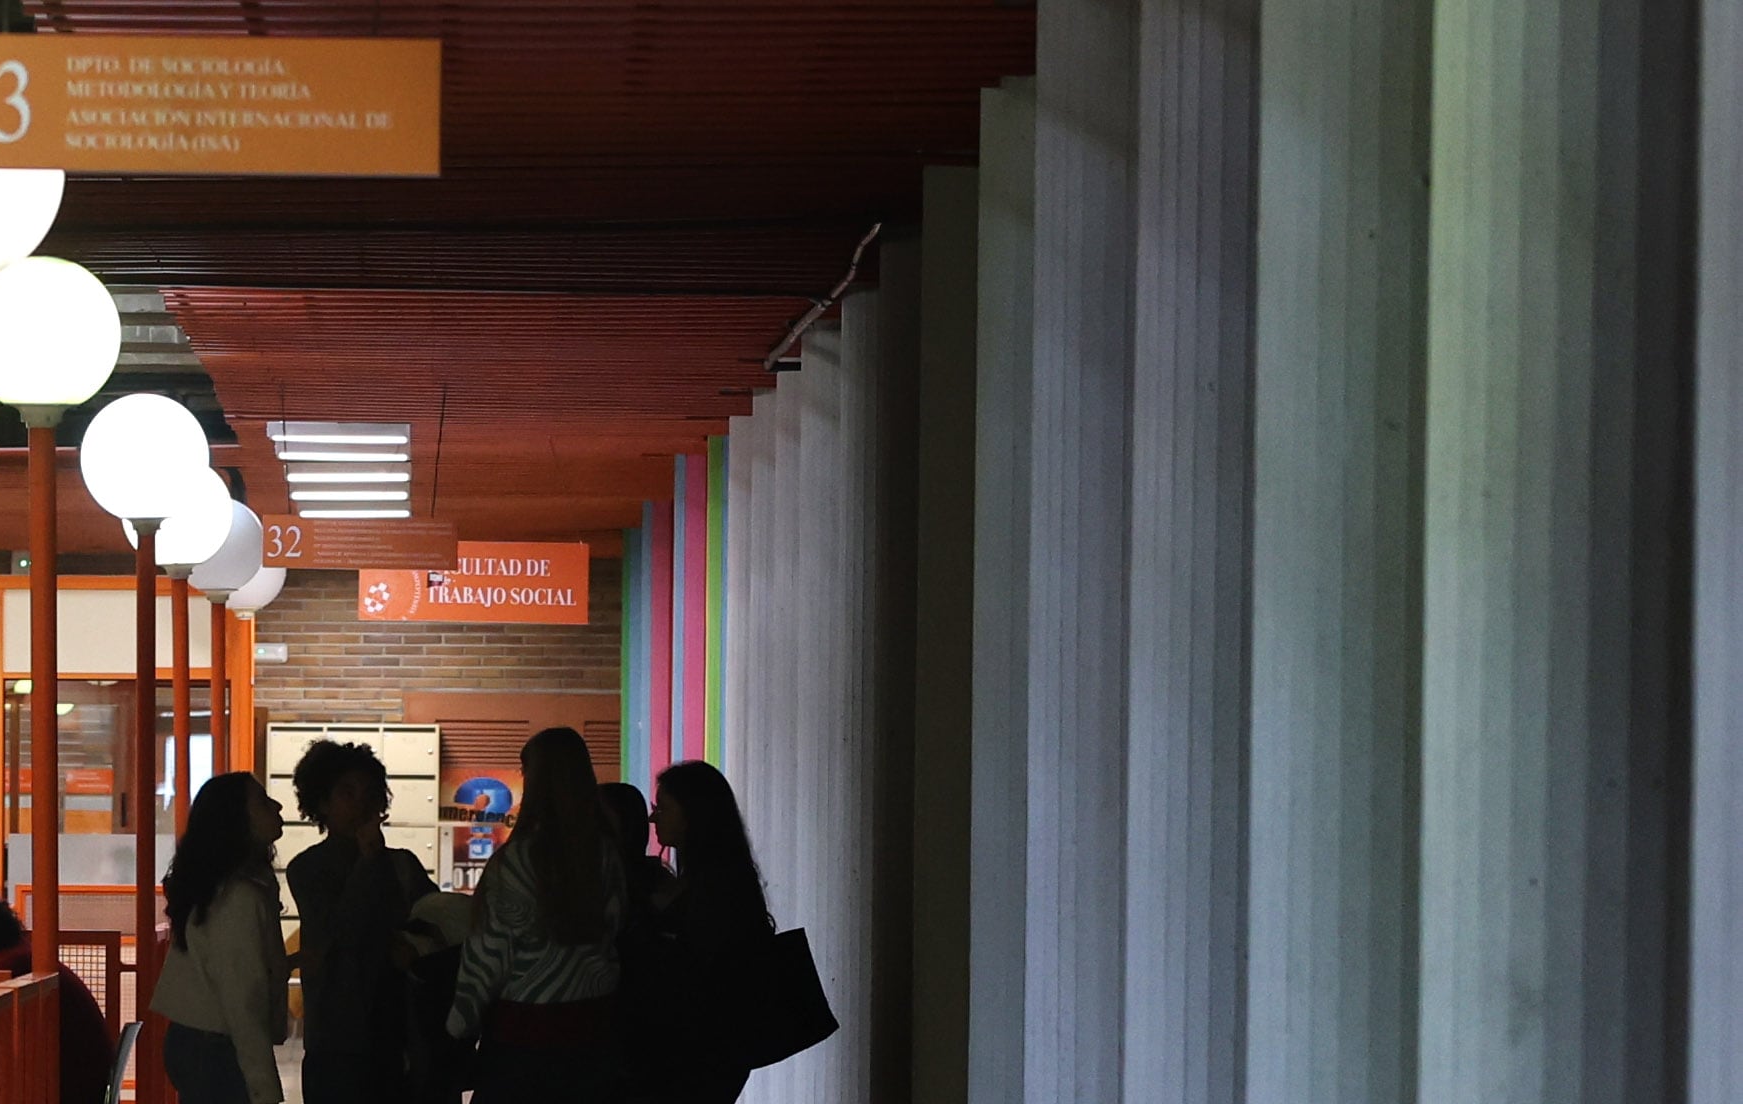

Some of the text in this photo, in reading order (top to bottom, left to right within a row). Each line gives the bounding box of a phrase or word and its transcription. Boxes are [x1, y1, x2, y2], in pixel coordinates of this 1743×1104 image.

[129, 58, 154, 74] DE
[218, 82, 232, 99] Y
[196, 110, 357, 128] INTERNACIONAL
[365, 111, 392, 129] DE
[266, 525, 303, 559] 32
[526, 558, 551, 577] DE
[427, 586, 506, 608] TRABAJO
[510, 587, 577, 606] SOCIAL
